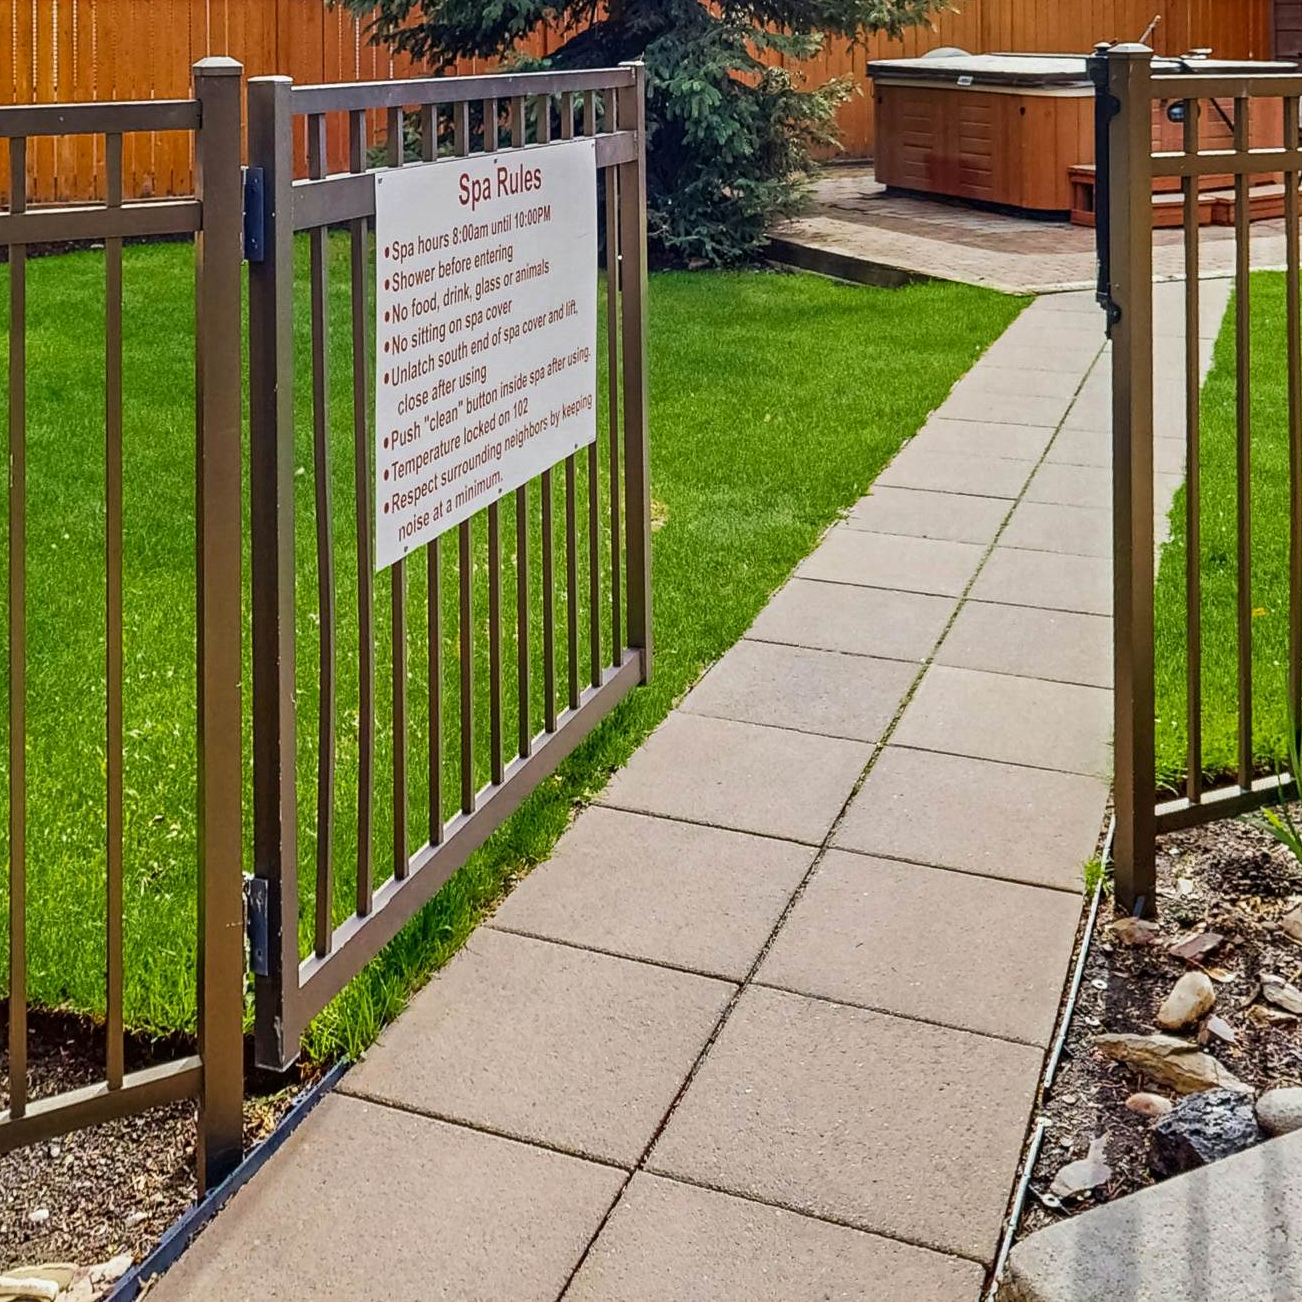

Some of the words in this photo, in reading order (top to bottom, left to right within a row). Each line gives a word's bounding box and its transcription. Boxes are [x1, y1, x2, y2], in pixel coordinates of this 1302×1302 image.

[459, 173, 491, 211] Spa
[497, 163, 541, 197] Rules
[392, 241, 414, 264] Spa
[418, 234, 449, 254] hours
[453, 224, 488, 245] 8:00am
[492, 214, 511, 235] until
[515, 205, 550, 229] 10:00PM
[392, 267, 435, 292] Shower
[439, 257, 472, 278] before
[474, 244, 513, 268] entering
[393, 303, 408, 324] No
[412, 292, 439, 317] food,
[443, 282, 472, 306] drink,
[476, 277, 501, 300] glass
[504, 273, 513, 286] or
[516, 259, 549, 283] animals
[392, 335, 408, 355] No
[412, 323, 445, 348] sitting
[449, 318, 462, 334] on
[465, 311, 483, 331] spa
[486, 300, 512, 321] cover
[392, 354, 434, 386] Unlatch
[438, 341, 468, 368] south
[471, 332, 489, 355] end
[492, 327, 502, 346] of
[504, 325, 520, 344] spa
[522, 314, 546, 334] cover
[548, 303, 564, 324] and
[392, 421, 420, 450] Push
[424, 400, 463, 431] "clean"
[467, 389, 497, 414] button
[501, 373, 527, 398] inside
[530, 367, 545, 386] spa
[547, 357, 566, 376] after
[568, 347, 590, 366] using.
[398, 391, 428, 415] close
[432, 378, 456, 401] after
[459, 366, 486, 389] using
[391, 435, 460, 481] Temperature
[464, 413, 495, 445] locked
[498, 410, 510, 426] on
[514, 397, 528, 418] 102
[392, 474, 438, 514] Respect
[441, 442, 502, 486] surrounding
[505, 418, 548, 451] neighbors
[550, 410, 560, 428] by
[562, 394, 592, 420] keeping
[399, 512, 429, 542] noise
[433, 501, 443, 521] at
[446, 499, 452, 513] a
[456, 471, 503, 508] minimum.
